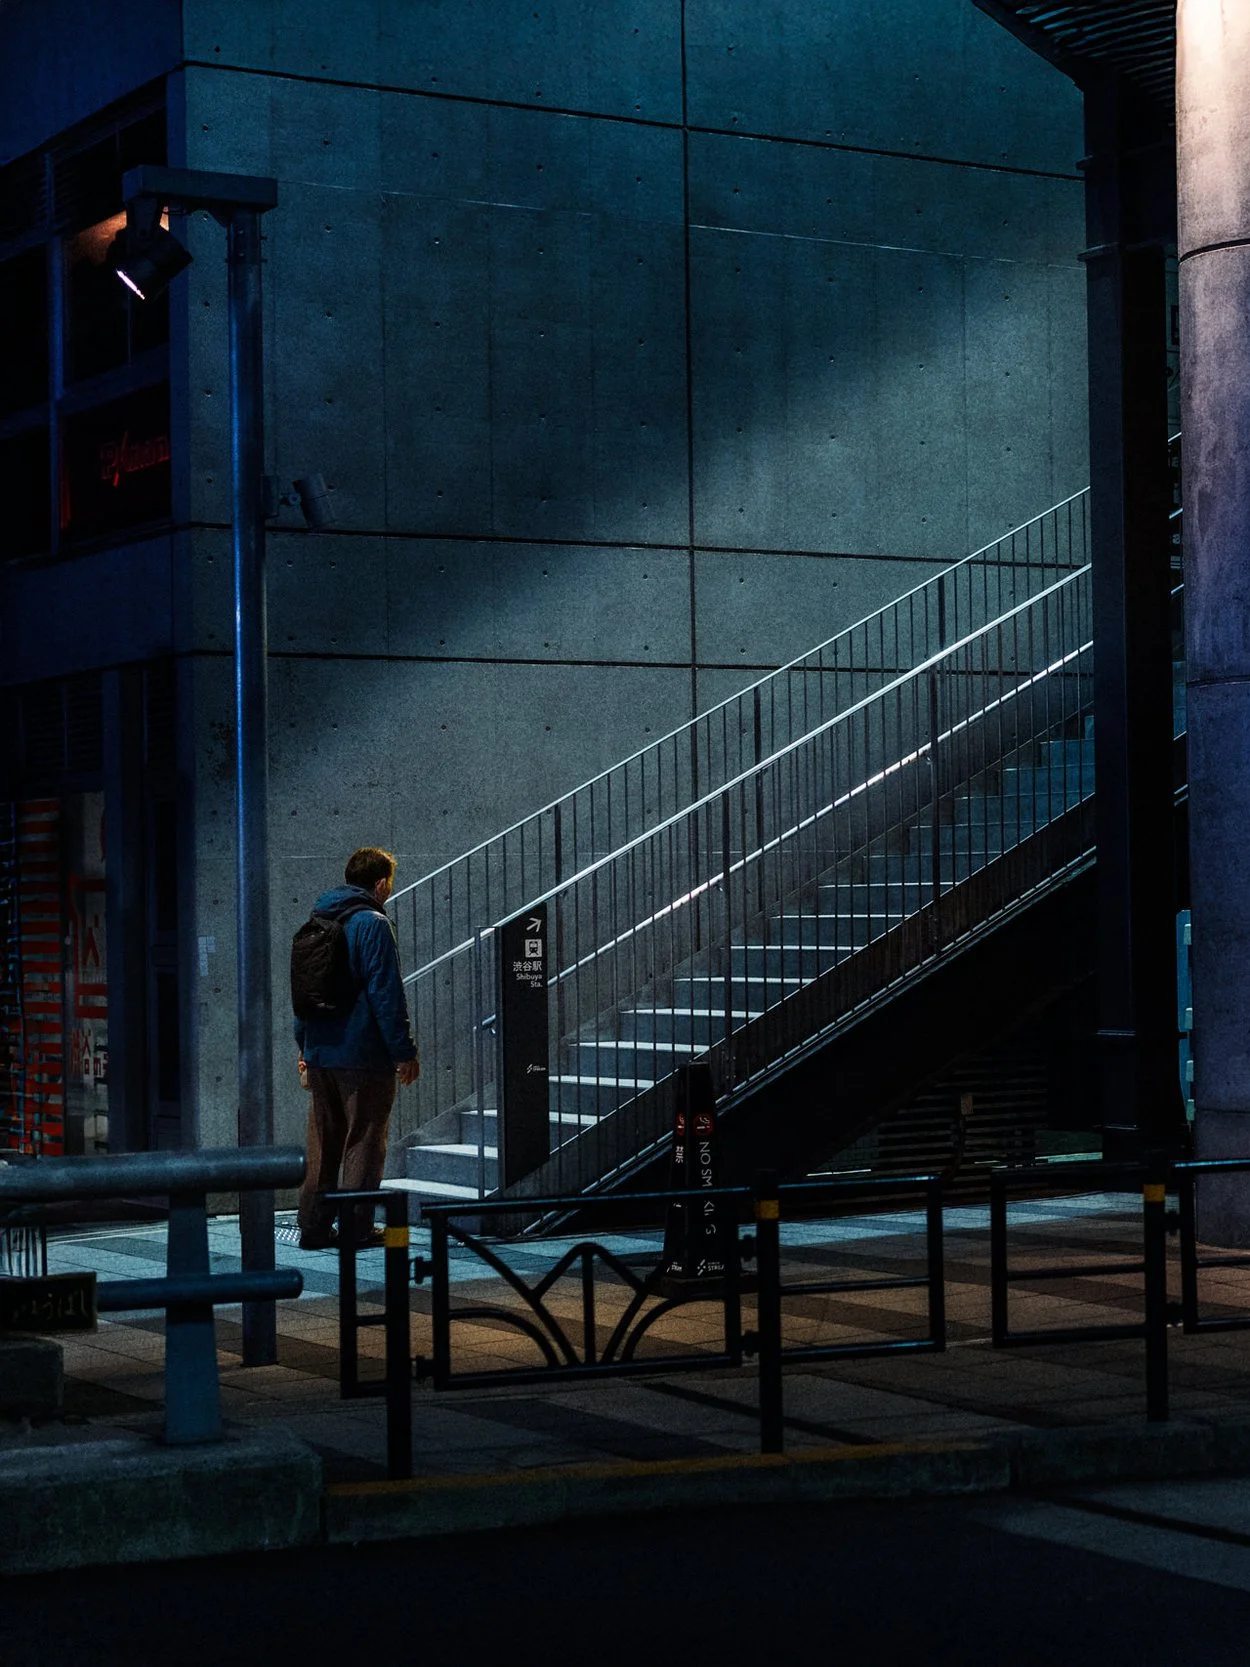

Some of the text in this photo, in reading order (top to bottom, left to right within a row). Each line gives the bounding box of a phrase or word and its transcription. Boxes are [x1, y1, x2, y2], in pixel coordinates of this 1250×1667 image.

[513, 961, 542, 972] 渋谷駅
[699, 1141, 712, 1165] NO
